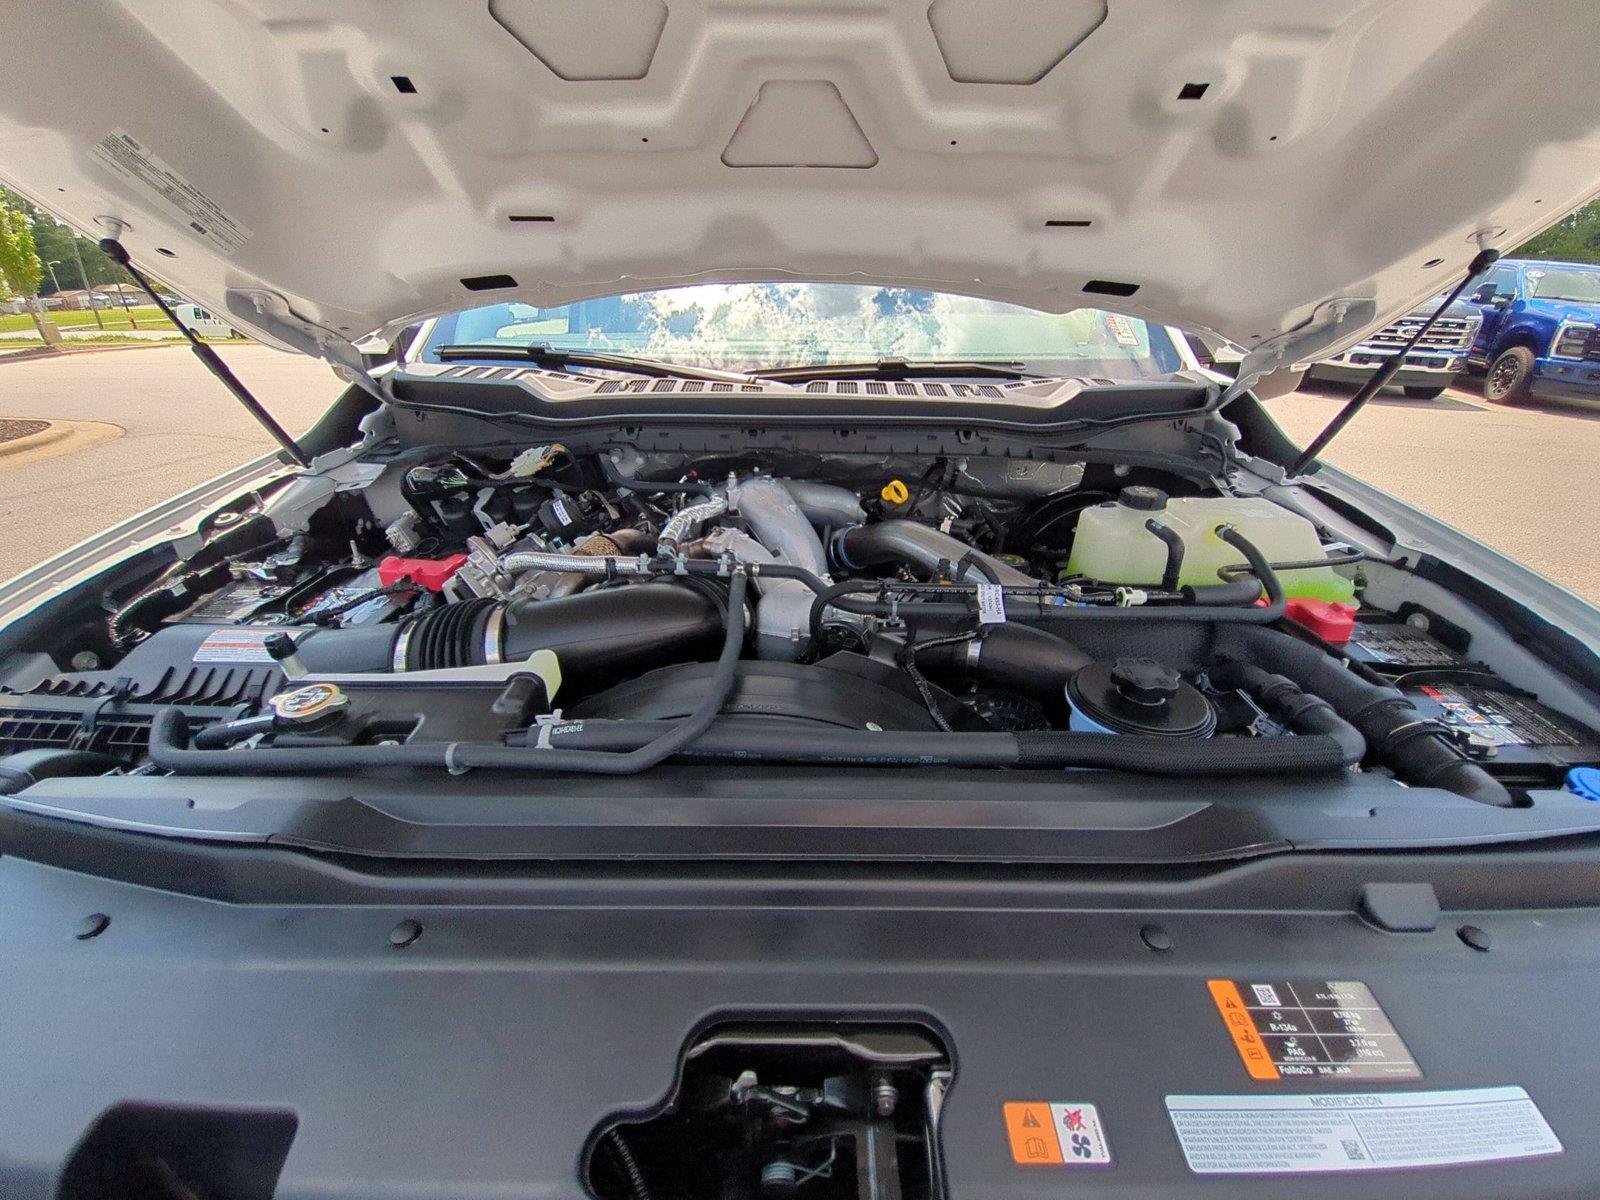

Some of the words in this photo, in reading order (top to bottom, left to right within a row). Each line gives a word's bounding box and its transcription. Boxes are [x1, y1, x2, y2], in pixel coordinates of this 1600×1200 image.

[1270, 1024, 1297, 1032] R-134a
[1287, 1048, 1306, 1056] PAG
[1279, 1066, 1313, 1075] FoMoCo
[1309, 1096, 1383, 1107] MODIFICATION
